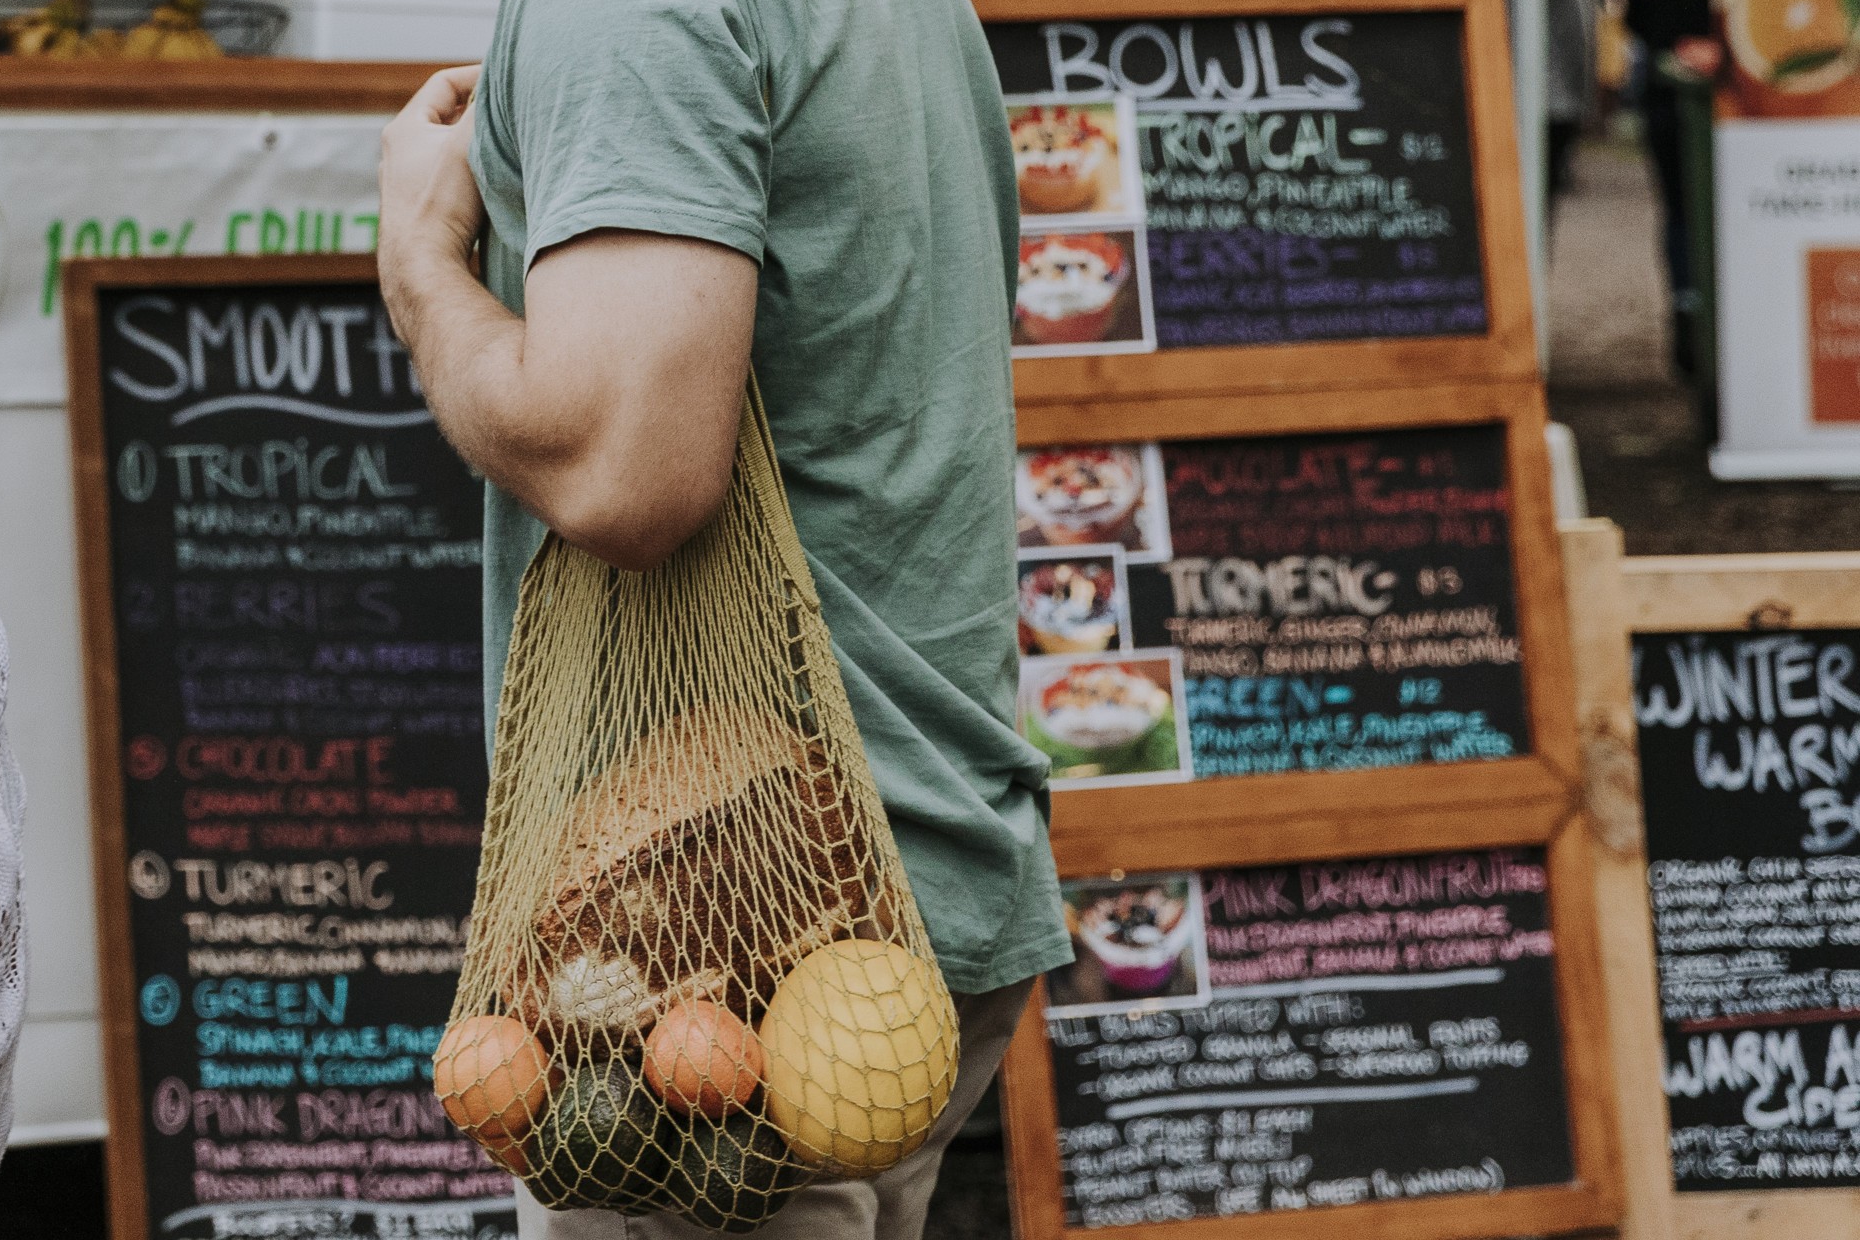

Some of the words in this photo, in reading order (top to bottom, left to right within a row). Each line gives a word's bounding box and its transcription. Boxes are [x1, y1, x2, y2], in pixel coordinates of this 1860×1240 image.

[1040, 18, 1362, 102] BOWLS
[162, 435, 420, 502] TROPICAL
[173, 857, 396, 912] TURMERIC
[192, 973, 349, 1026] GREEN
[1662, 1029, 1807, 1099] WARM
